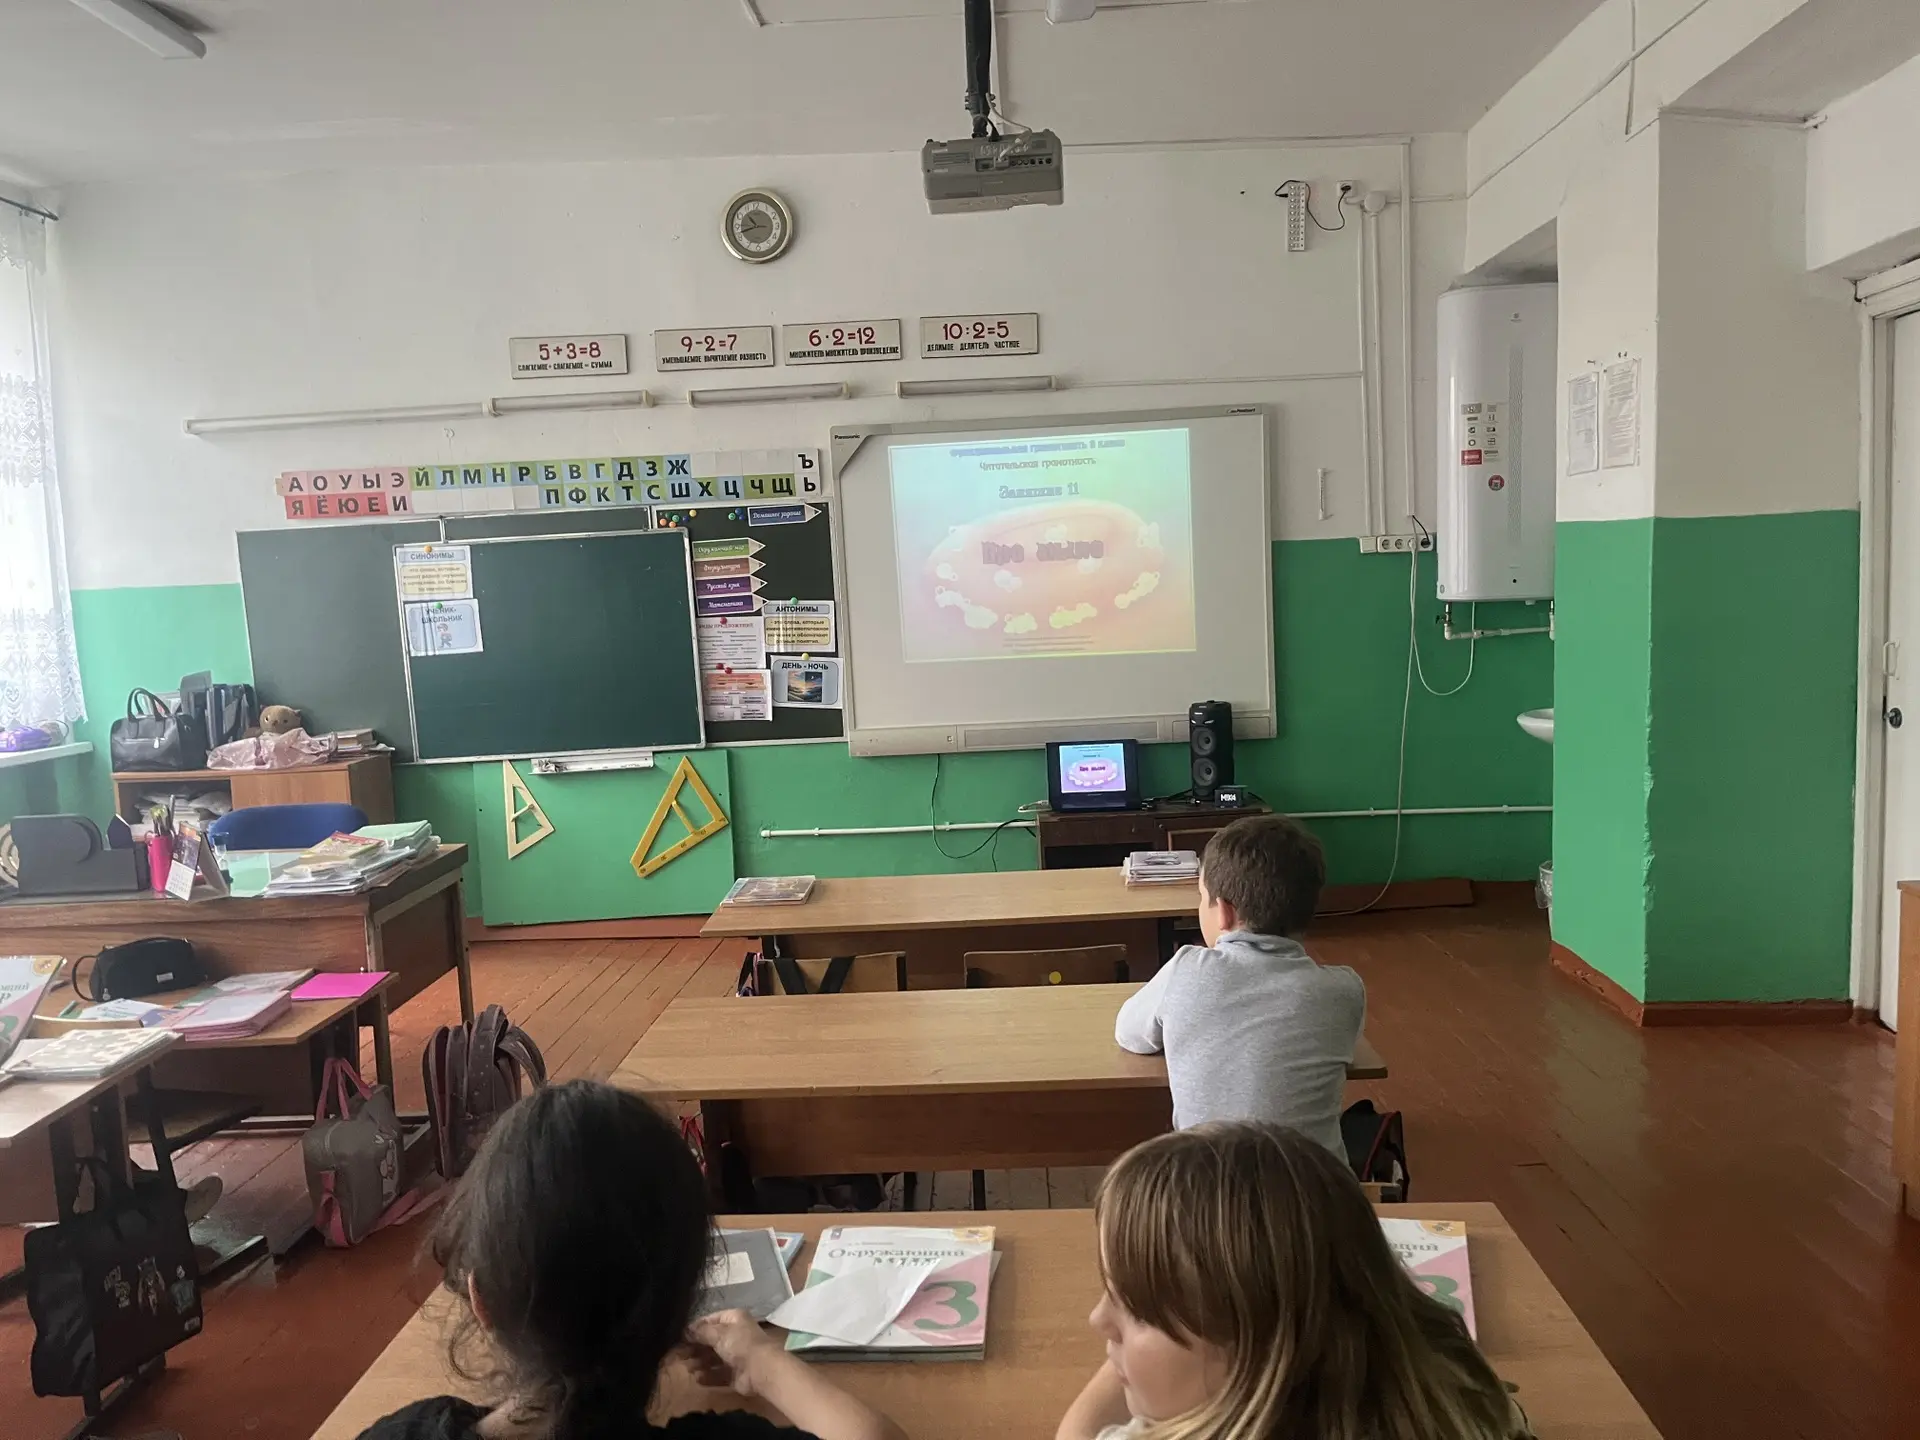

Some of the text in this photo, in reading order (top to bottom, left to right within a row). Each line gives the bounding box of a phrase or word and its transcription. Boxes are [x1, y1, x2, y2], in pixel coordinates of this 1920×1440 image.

[927, 340, 1020, 352] ДЕЛИМОЕ ДЕЛИТЕЛЬ ЧАСТНОЕ
[739, 352, 767, 361] РАЗНОСТЬ
[591, 360, 613, 369] СУММА
[1041, 457, 1097, 469] грамотность
[289, 454, 813, 492] А О У Ы Э Й Л М Н Р Б В Г Д З Ж Ъ
[291, 477, 815, 516] Я Ё Ю Е И П Ф К Т С Ш Х Ц Ч Щ Ь
[410, 552, 455, 560] СИНОНИМЫ
[808, 662, 829, 670] НОЧЬ
[828, 1248, 965, 1259] Окружающий
[914, 1280, 980, 1330] 3
